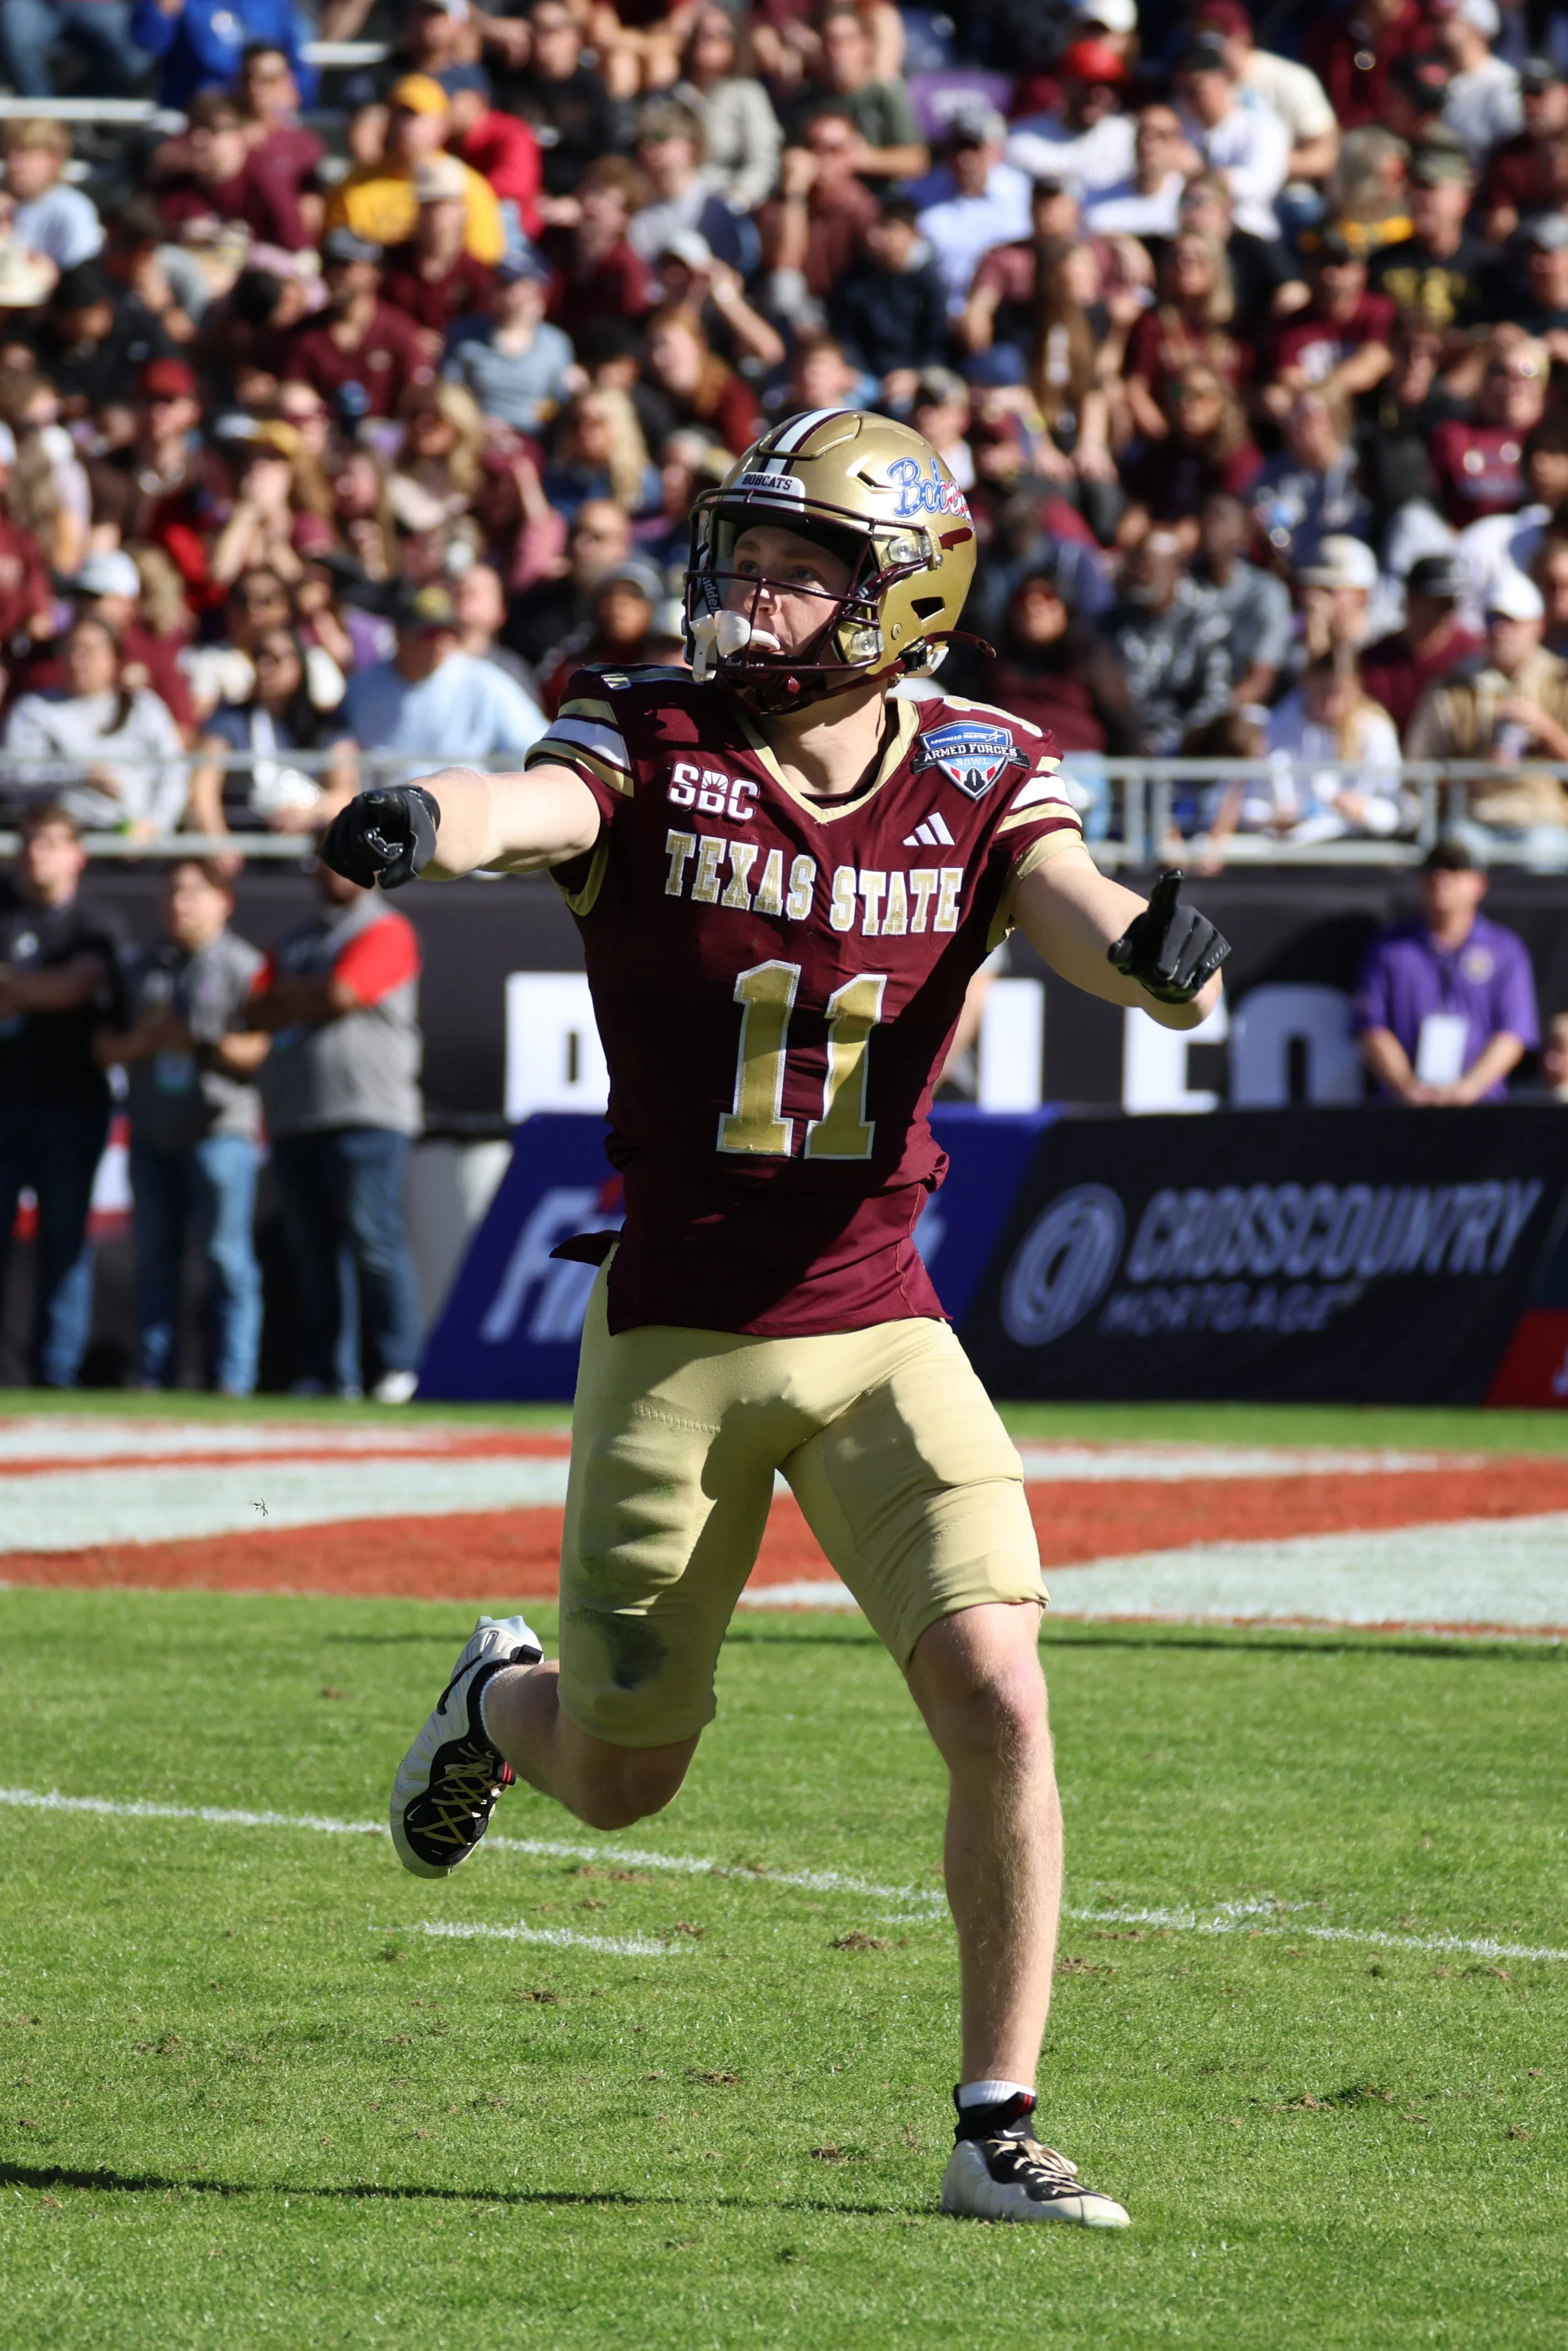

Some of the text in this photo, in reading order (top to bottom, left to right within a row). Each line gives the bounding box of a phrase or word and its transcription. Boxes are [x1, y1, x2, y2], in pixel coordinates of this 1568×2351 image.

[742, 474, 792, 490] BOBCATS
[702, 565, 721, 615] iddel
[924, 743, 1018, 762] ARMED FORCES
[956, 757, 990, 766] BOWL
[669, 762, 760, 820] SBC
[664, 829, 964, 936] TEXAS STATE
[716, 959, 887, 1159] 11
[1128, 1177, 1544, 1283] CROSSCOUNTRY
